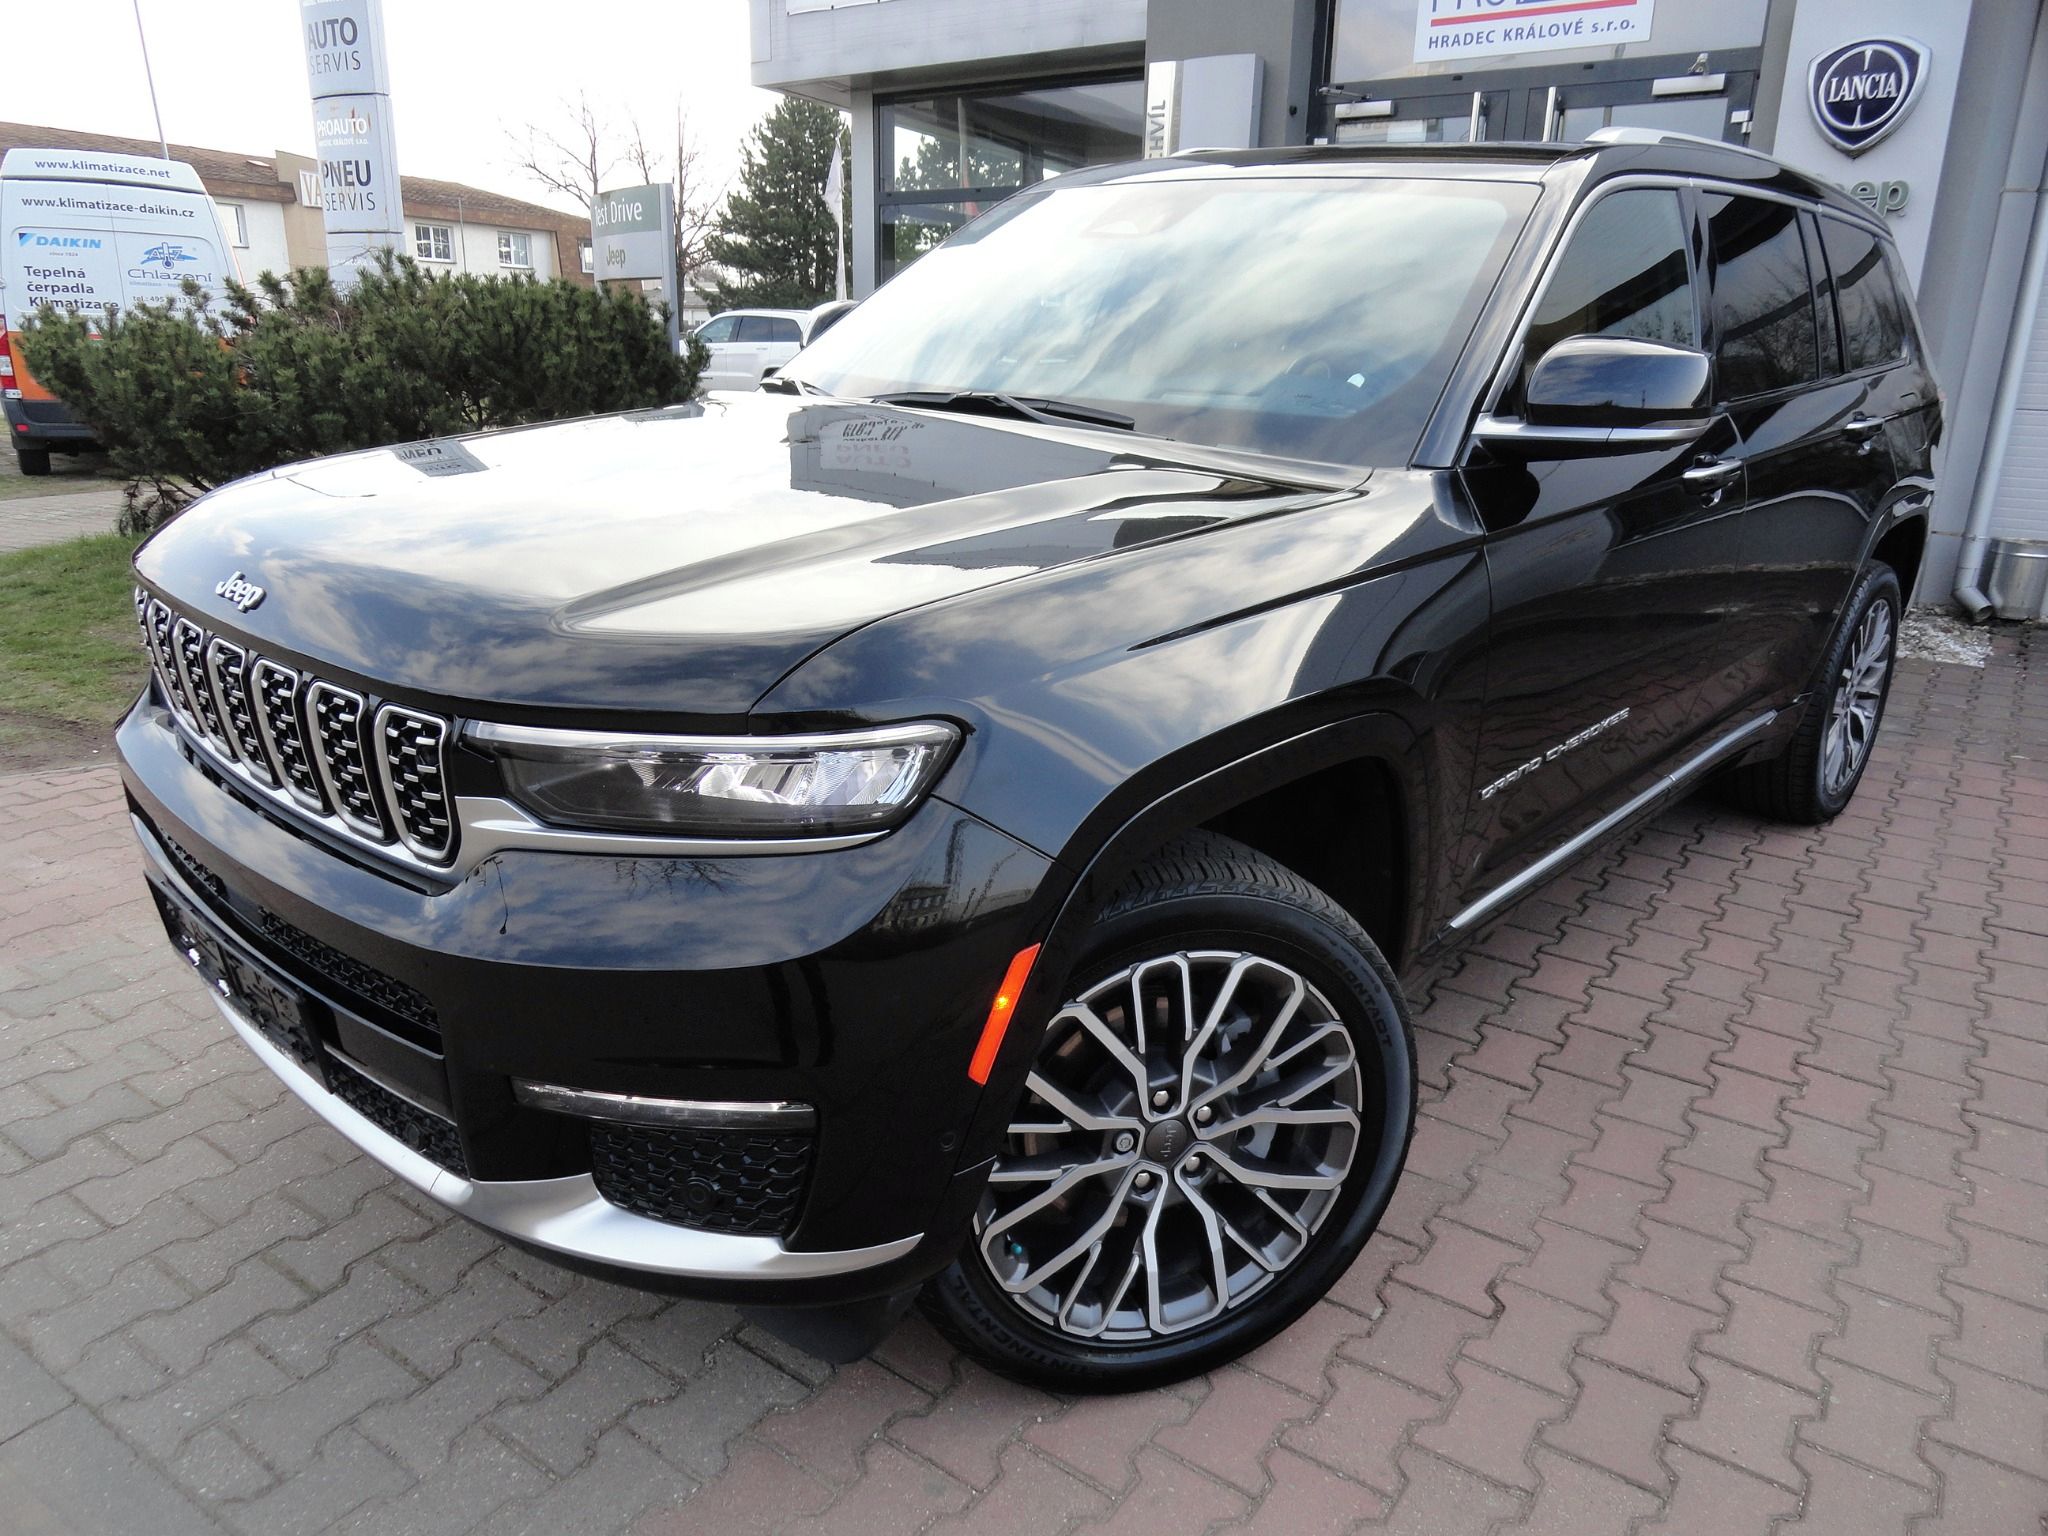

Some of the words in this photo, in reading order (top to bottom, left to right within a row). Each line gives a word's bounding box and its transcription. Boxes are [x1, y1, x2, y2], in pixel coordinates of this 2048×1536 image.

[308, 17, 358, 51] AUTO
[1428, 30, 1495, 50] HRADEC
[1503, 17, 1584, 43] KRÁLOVÉ
[1591, 19, 1636, 34] s.r.o.
[310, 50, 361, 76] SERVIS
[1827, 71, 1898, 103] LANCIA
[316, 117, 367, 137] PROAUTO
[35, 160, 171, 179] www.klimatizace.net
[321, 160, 372, 188] PNEU
[21, 197, 195, 218] www.klimatizace-daikin.cz
[325, 192, 376, 212] SERVIS
[595, 204, 608, 227] Test
[610, 198, 643, 224] Drive
[36, 236, 102, 249] DAIKIN
[606, 245, 626, 269] Jeep
[23, 265, 86, 280] Tepelná
[27, 281, 95, 295] čerpadla
[215, 571, 266, 613] Jeep
[1481, 757, 1542, 800] GRAND
[1546, 707, 1630, 762] CHEROKEE
